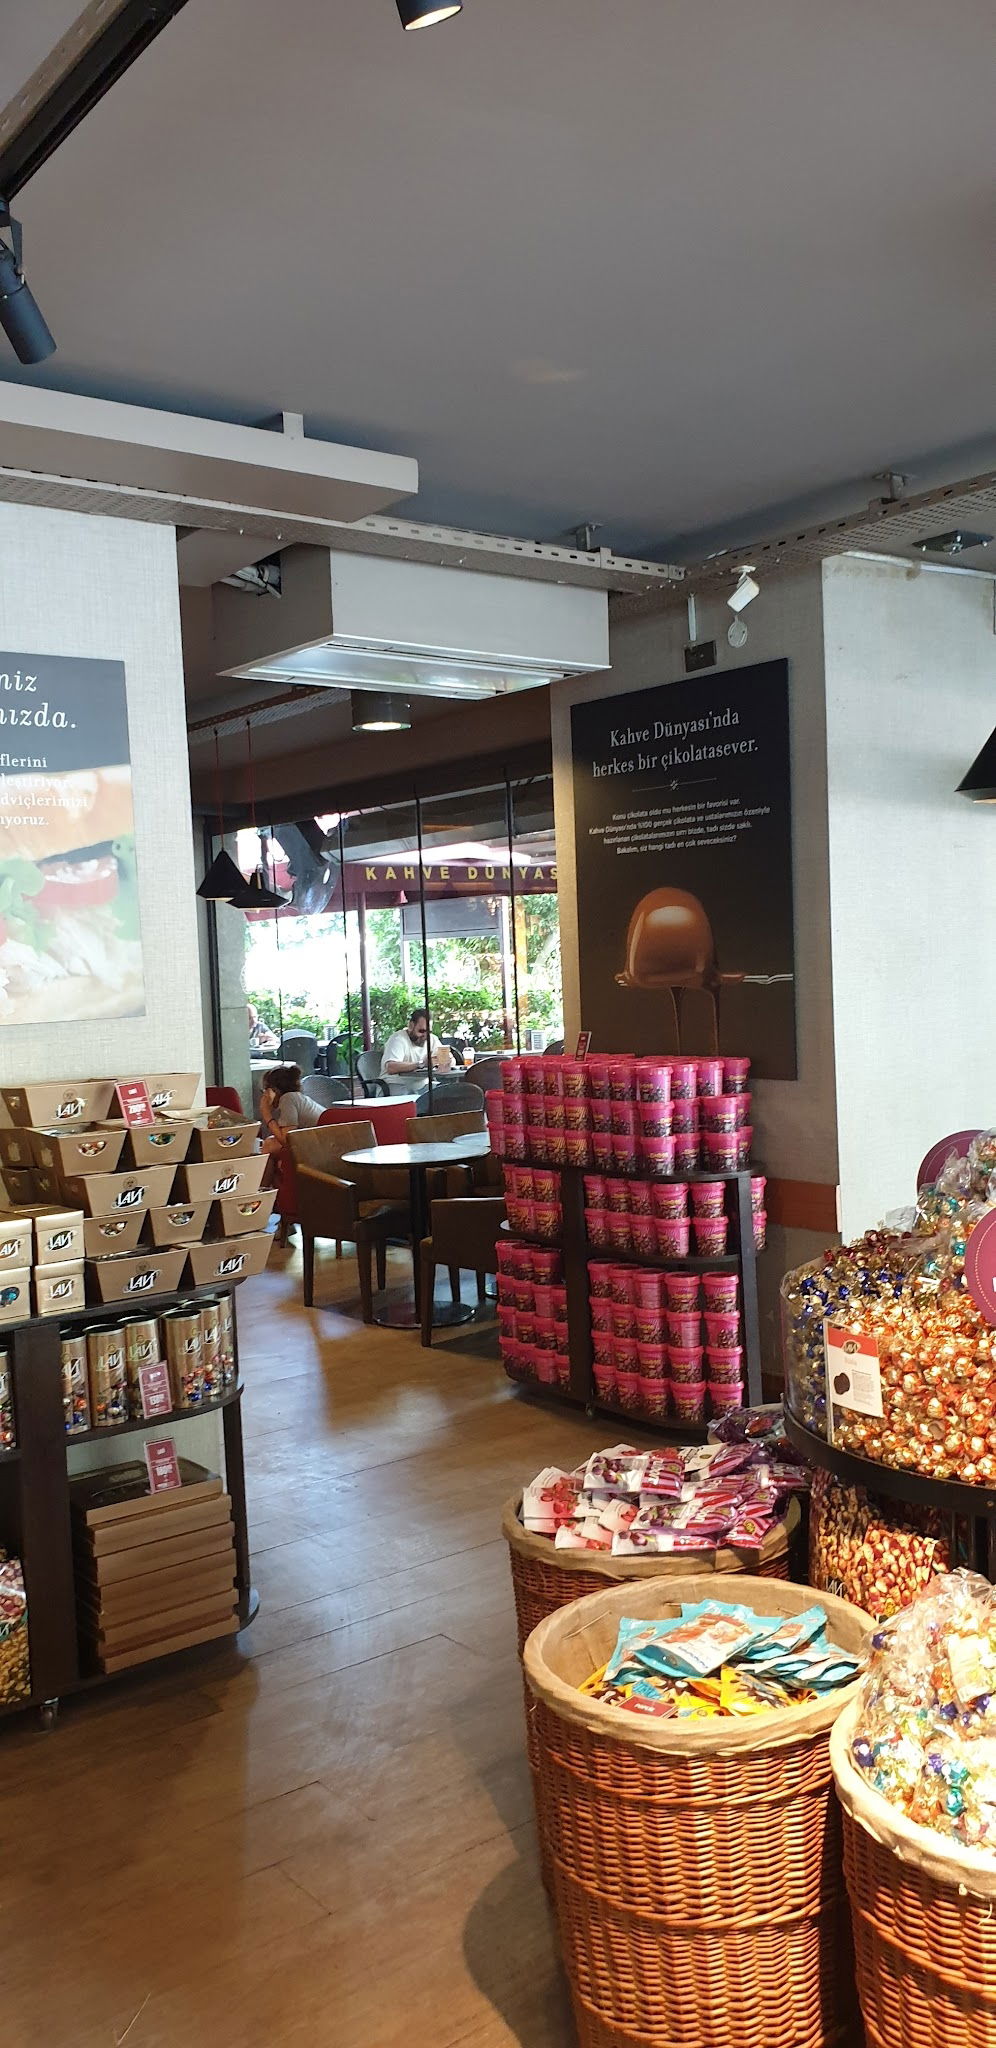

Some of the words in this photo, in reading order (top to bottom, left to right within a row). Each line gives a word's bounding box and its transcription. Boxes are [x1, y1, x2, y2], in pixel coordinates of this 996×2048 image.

[610, 727, 650, 748] Kahve
[654, 707, 740, 740] Dünyası'nda
[593, 756, 634, 778] herkes
[638, 754, 657, 770] bir
[661, 739, 759, 771] çikolatasever.
[627, 810, 648, 820] çikolata
[672, 804, 697, 813] herkesin
[697, 802, 706, 810] bir
[706, 799, 729, 809] favorisi
[588, 827, 605, 835] Kahve
[653, 819, 672, 829] gerçek
[673, 816, 696, 826] çikolata
[719, 823, 736, 832] sizde
[685, 839, 696, 848] çok
[365, 866, 450, 881] KAHVE
